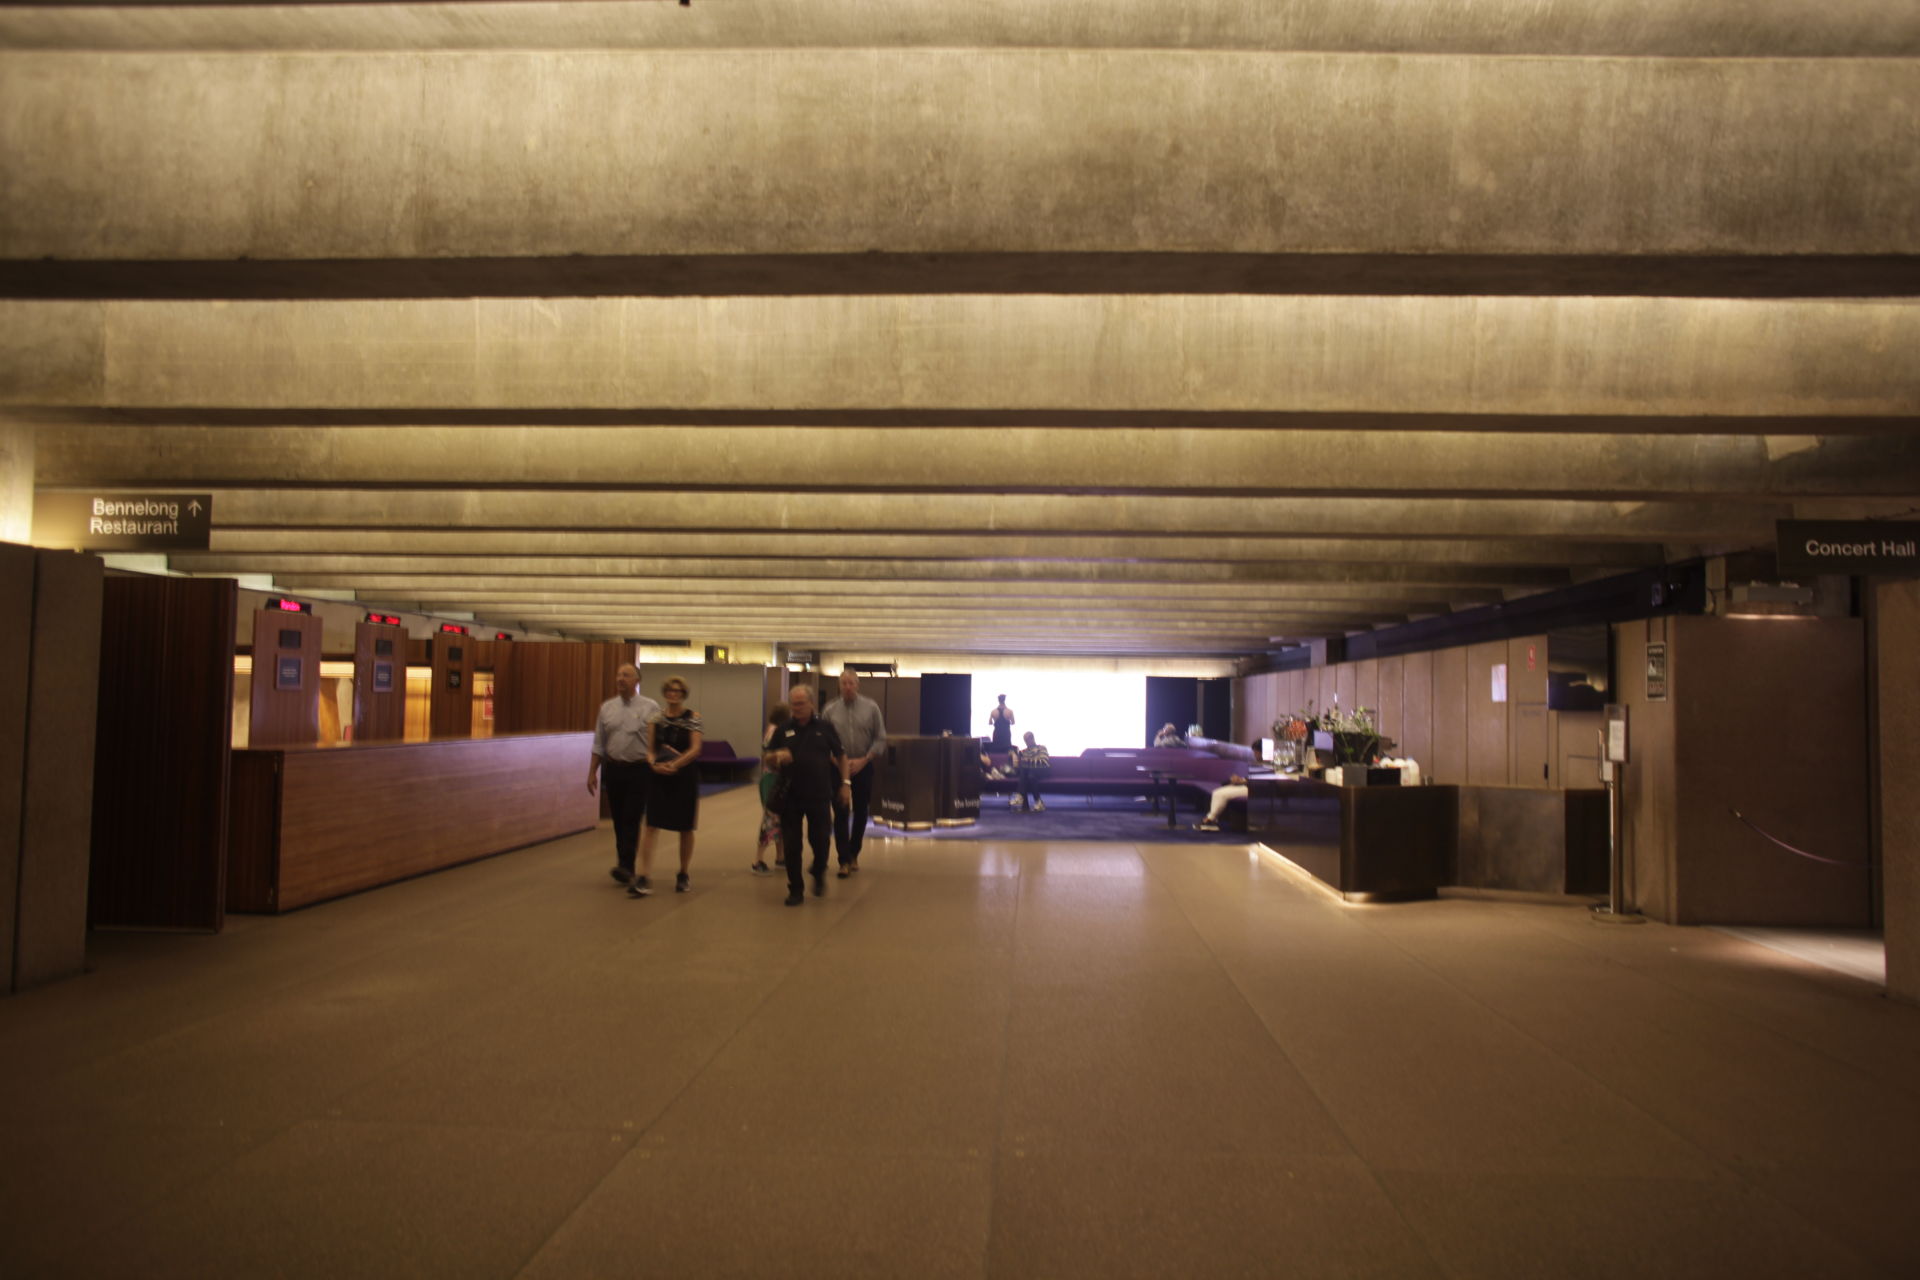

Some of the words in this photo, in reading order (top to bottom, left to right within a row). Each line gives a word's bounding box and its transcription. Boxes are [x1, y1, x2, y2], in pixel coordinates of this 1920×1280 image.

[93, 498, 178, 519] Bennelong
[90, 517, 178, 535] Restaurant
[1806, 540, 1876, 556] Concert
[1882, 541, 1916, 557] Hall
